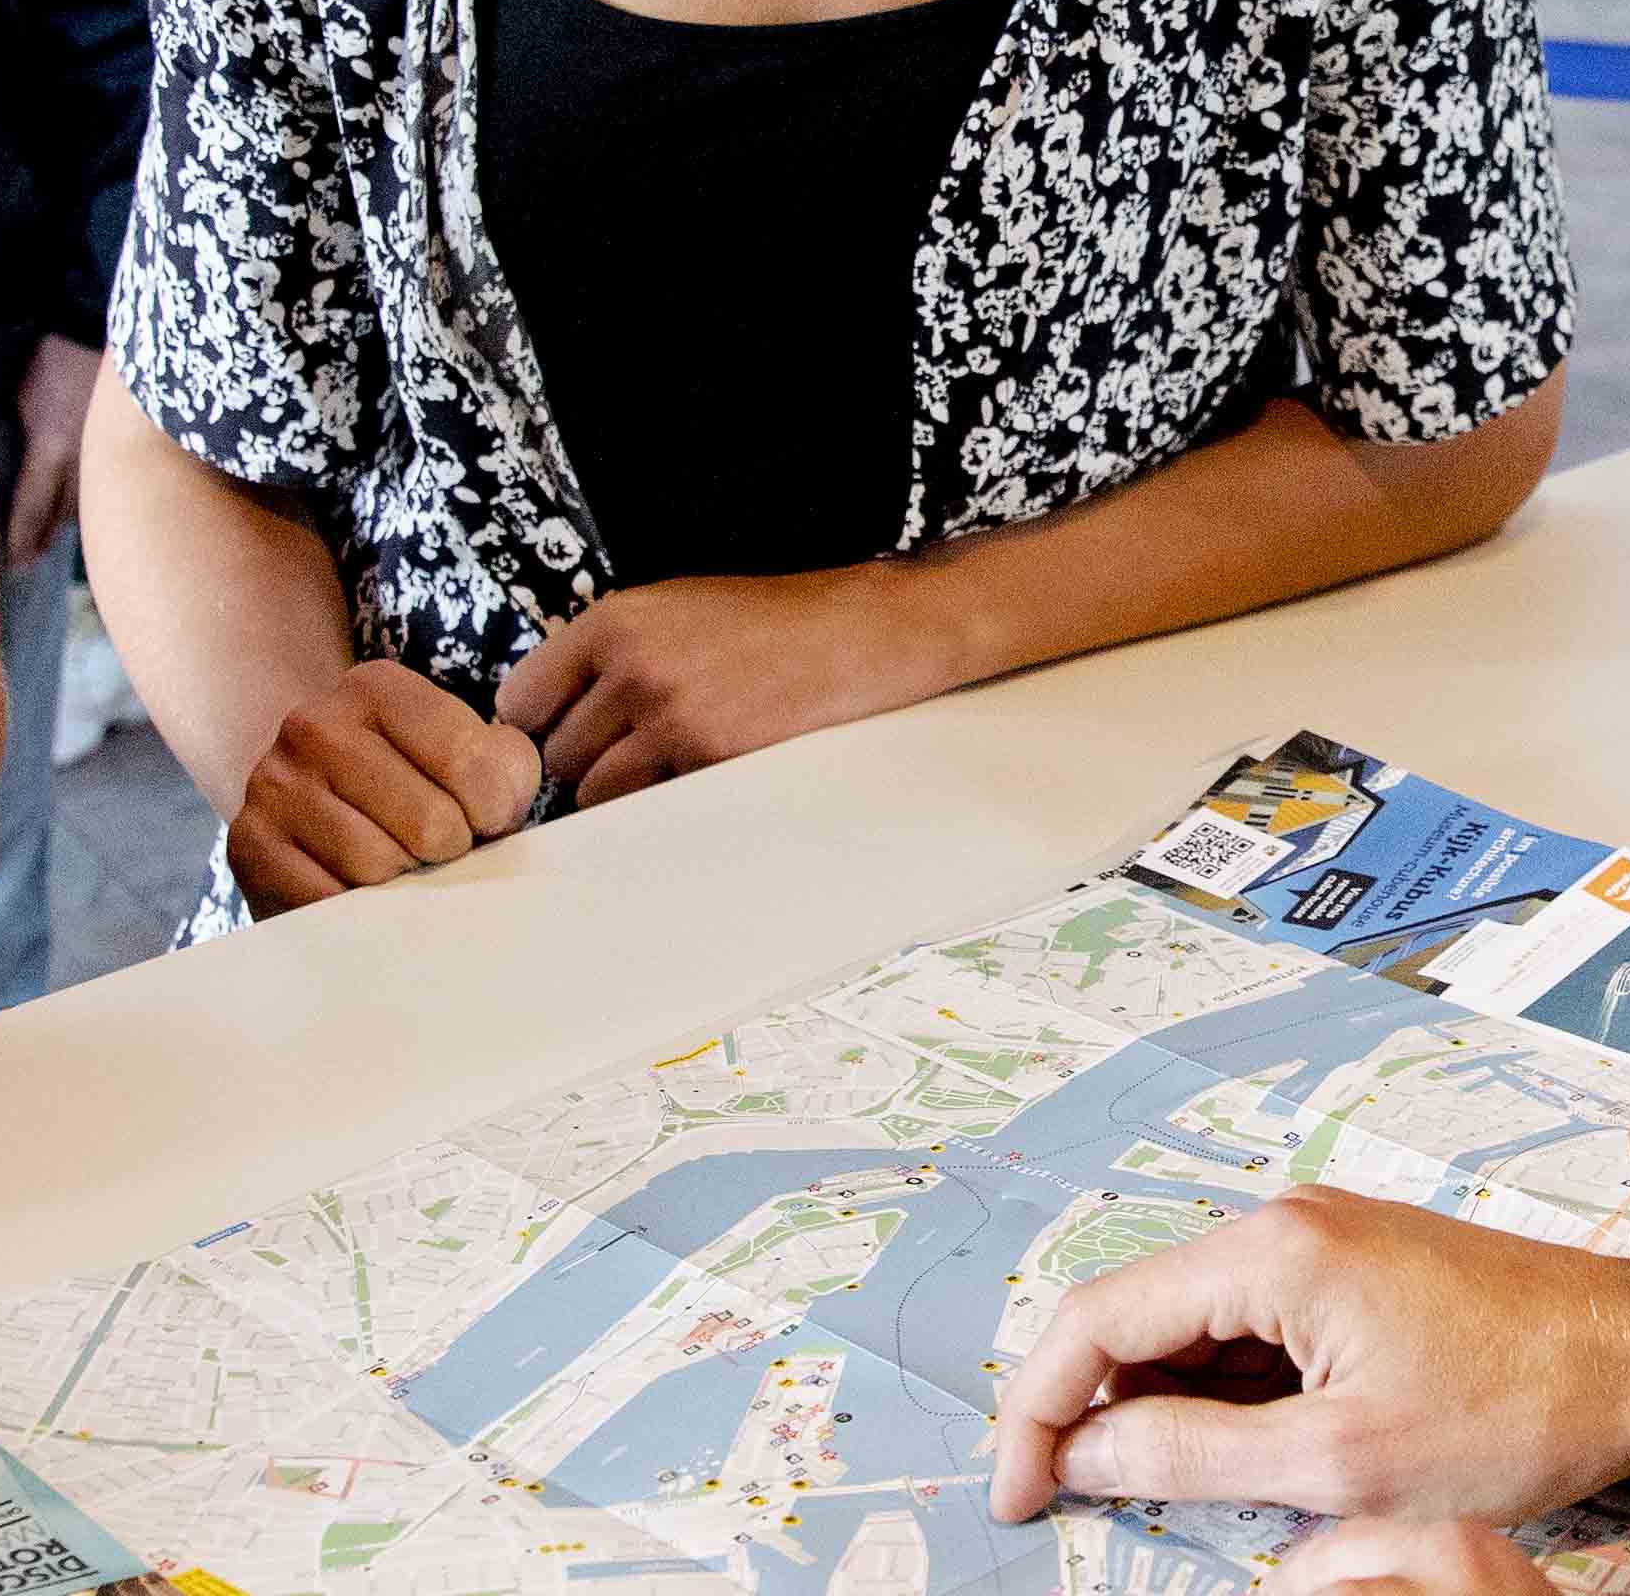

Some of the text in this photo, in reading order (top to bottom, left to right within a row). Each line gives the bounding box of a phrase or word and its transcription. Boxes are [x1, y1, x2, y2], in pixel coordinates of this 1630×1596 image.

[1351, 802, 1470, 929] Museum-cubehouse
[1384, 820, 1488, 923] Kijk-Kubus
[1447, 826, 1517, 901] architecture?
[1472, 851, 1520, 900] possible
[1292, 874, 1339, 919] cube-house
[1307, 879, 1353, 921] remarkable
[1324, 886, 1363, 920] Visit this
